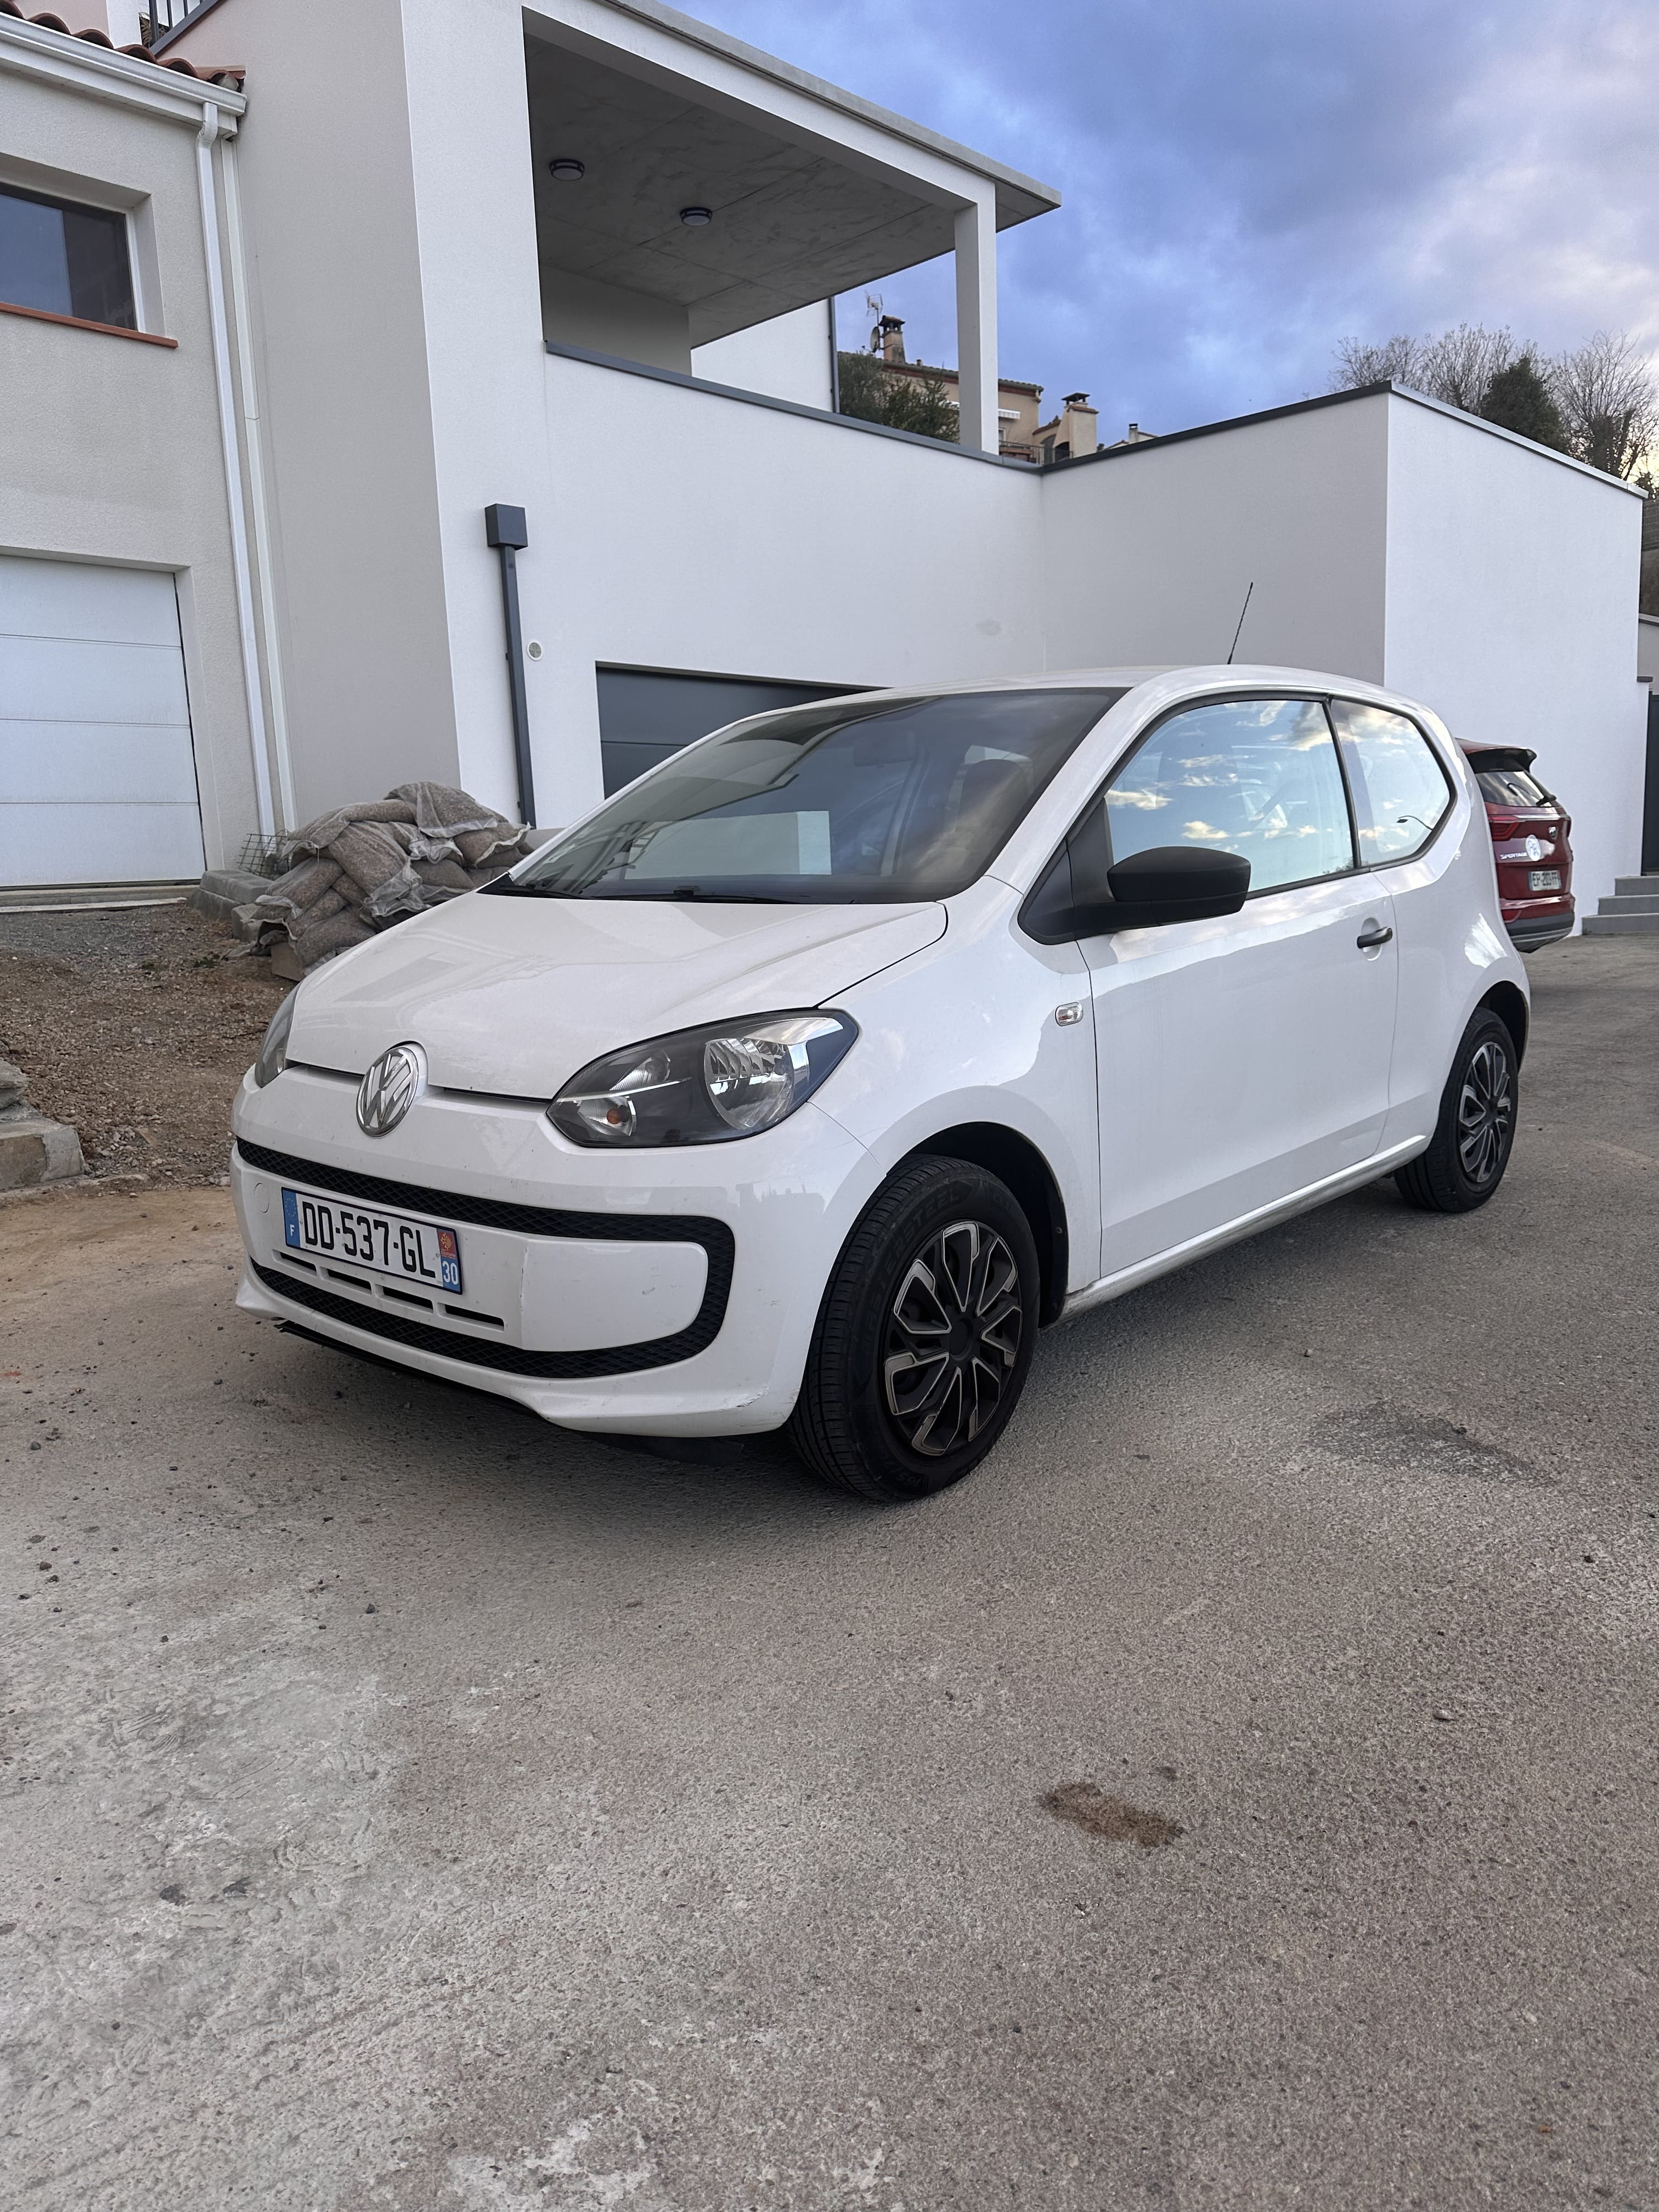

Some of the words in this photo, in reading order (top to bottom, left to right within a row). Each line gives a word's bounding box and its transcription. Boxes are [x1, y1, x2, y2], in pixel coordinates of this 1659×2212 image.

[289, 1224, 295, 1237] F
[302, 1200, 436, 1278] DD-537-GL
[442, 1260, 459, 1285] 30
